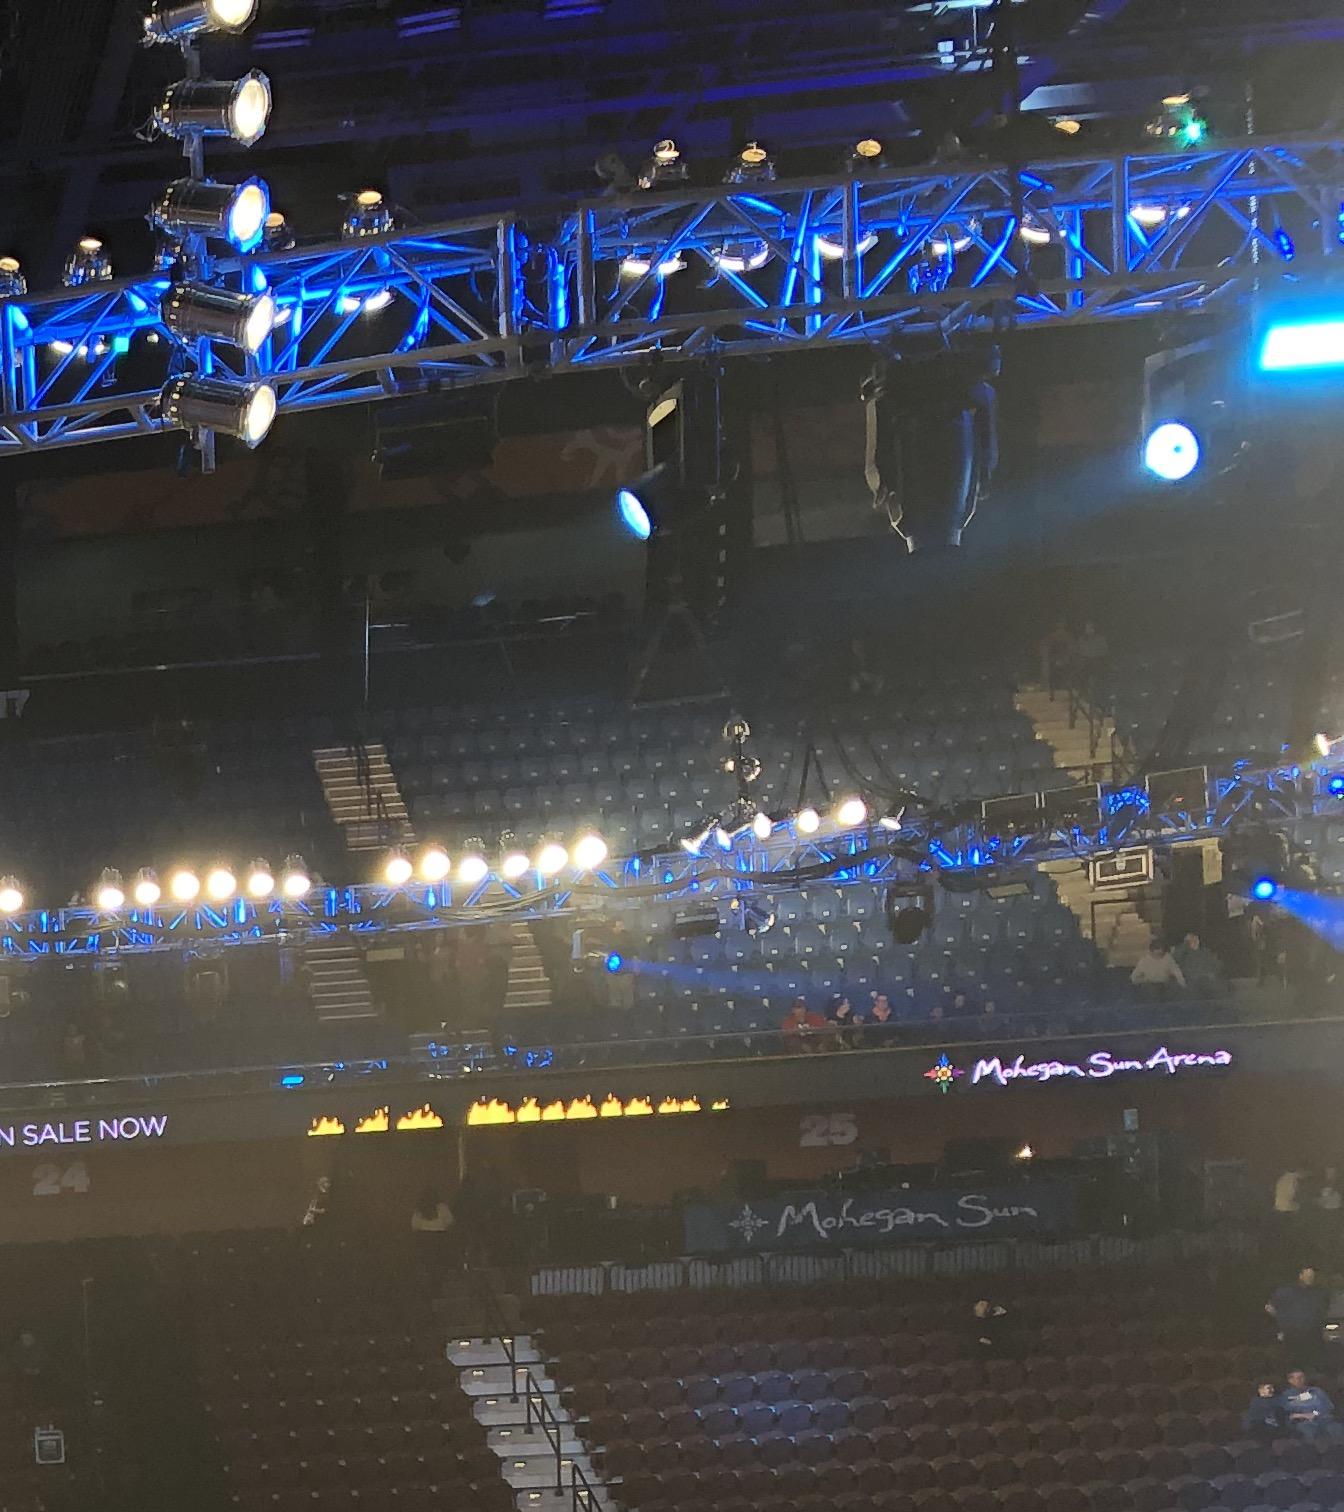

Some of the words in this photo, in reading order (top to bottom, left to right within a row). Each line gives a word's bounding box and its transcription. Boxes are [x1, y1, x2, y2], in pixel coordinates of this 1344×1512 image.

[971, 1053, 1086, 1086] Mohegan
[1087, 1050, 1143, 1078] Sun
[1145, 1046, 1233, 1074] Arena
[22, 1120, 92, 1146] SALE
[98, 1115, 169, 1141] NOW
[799, 1112, 859, 1147] 25
[31, 1162, 91, 1196] 24
[776, 1198, 951, 1239] Mohegan
[955, 1194, 1039, 1228] Sun
